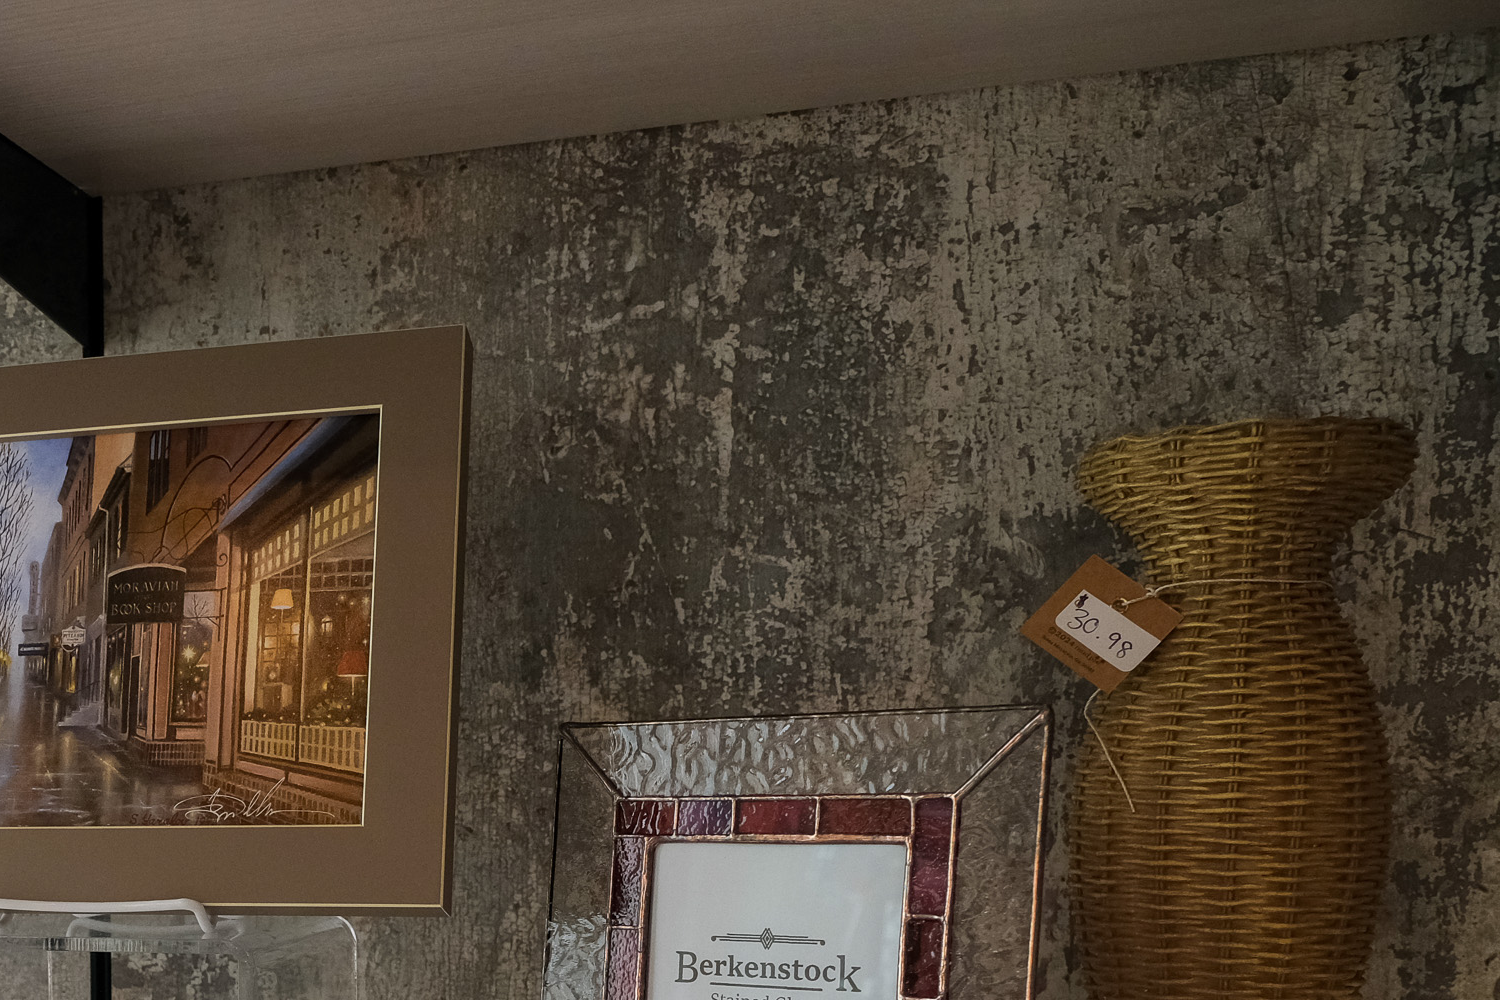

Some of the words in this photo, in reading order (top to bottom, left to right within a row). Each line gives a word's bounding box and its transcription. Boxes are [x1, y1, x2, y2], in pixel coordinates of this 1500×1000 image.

[113, 580, 179, 594] MORAVIAN
[111, 603, 141, 616] BOOK
[145, 601, 177, 614] SHOP
[674, 950, 862, 993] Berkenstock
